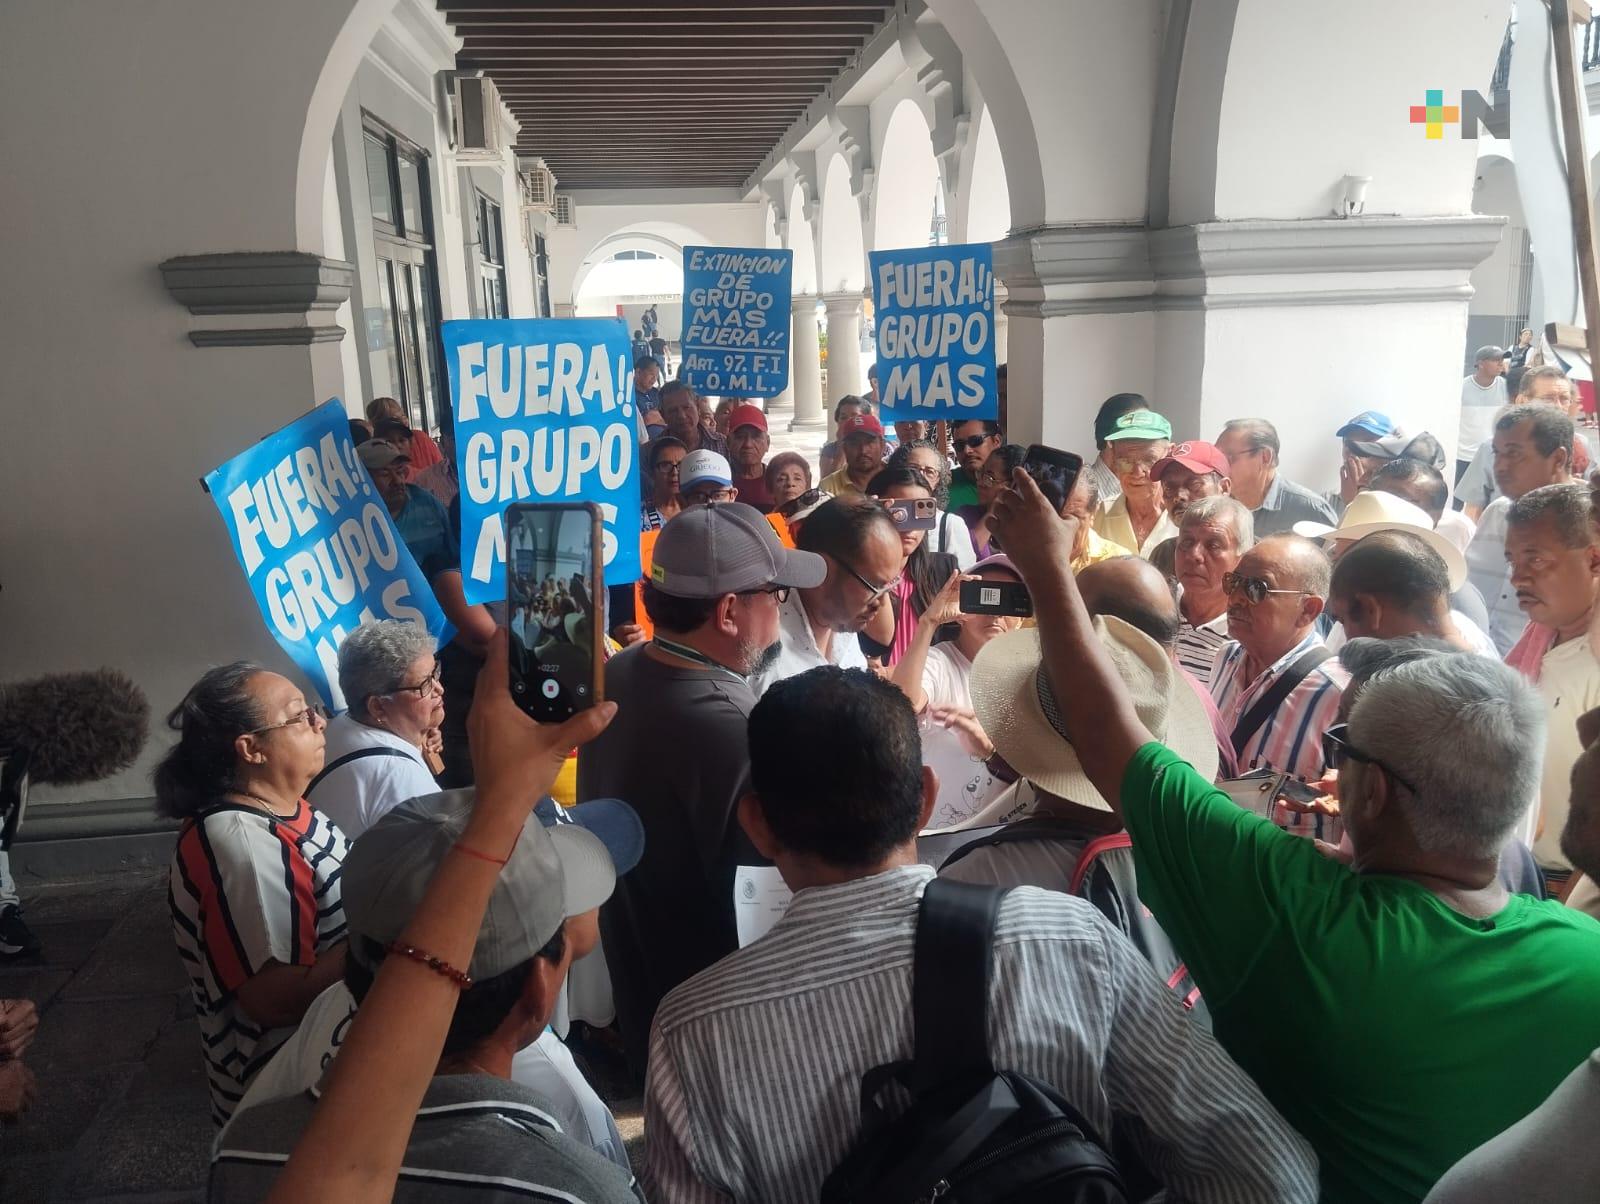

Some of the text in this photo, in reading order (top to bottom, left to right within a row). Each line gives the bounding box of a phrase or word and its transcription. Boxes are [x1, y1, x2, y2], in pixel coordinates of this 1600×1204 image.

[690, 250, 787, 275] EXTINCION
[717, 272, 754, 290] DE
[878, 257, 993, 311] FUERA!!
[689, 288, 774, 310] GRUPO
[692, 307, 767, 328] MAS
[879, 311, 988, 359] GRUPO
[457, 342, 635, 422] FUERA!!
[724, 354, 747, 372] 97.
[881, 362, 986, 408] MAS
[465, 422, 632, 504] GRUPO
[228, 431, 371, 578] FUERA!!
[265, 502, 399, 642] GRUPO
